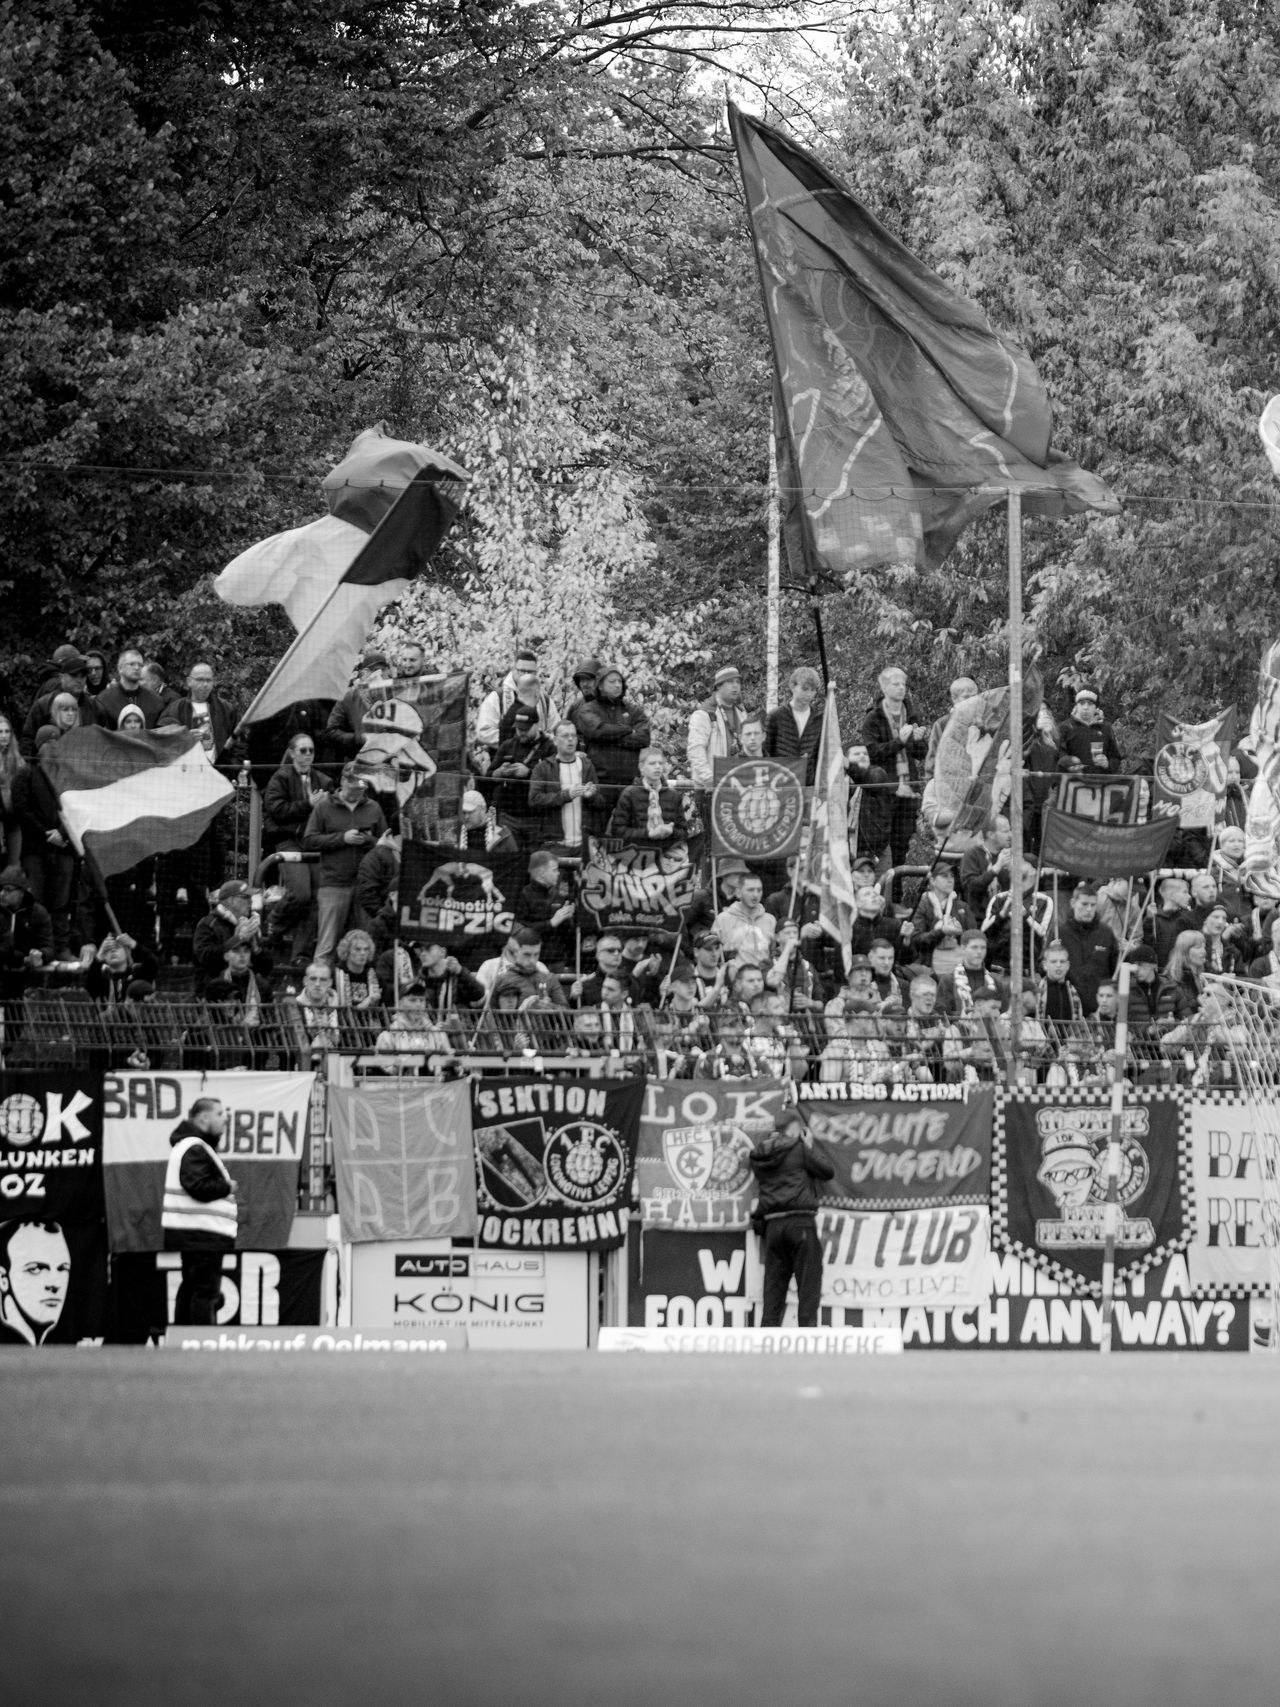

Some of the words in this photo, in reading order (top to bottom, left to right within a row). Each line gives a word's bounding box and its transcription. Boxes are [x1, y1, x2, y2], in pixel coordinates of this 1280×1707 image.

[400, 905, 515, 934] LEIPZIG
[103, 1076, 182, 1119] BAD
[479, 1083, 607, 1117] SEKTION
[640, 1084, 783, 1123] LOK
[801, 1082, 848, 1100] ANTI
[891, 1083, 964, 1101] ACTION
[672, 1131, 705, 1145] HFC
[1056, 1135, 1075, 1143] LOK
[550, 1153, 593, 1200] LOKOMOTIVE
[594, 1157, 619, 1195] LEIPZIG
[851, 1144, 982, 1184] JUGEND
[428, 1167, 460, 1225] B
[641, 1196, 750, 1228] HALL
[874, 1210, 979, 1268] CLUB
[399, 1259, 467, 1273] AUTO
[474, 1261, 540, 1271] HAUS
[394, 1285, 545, 1313] KÖNIG
[471, 1319, 544, 1328] MITTELPUNKT
